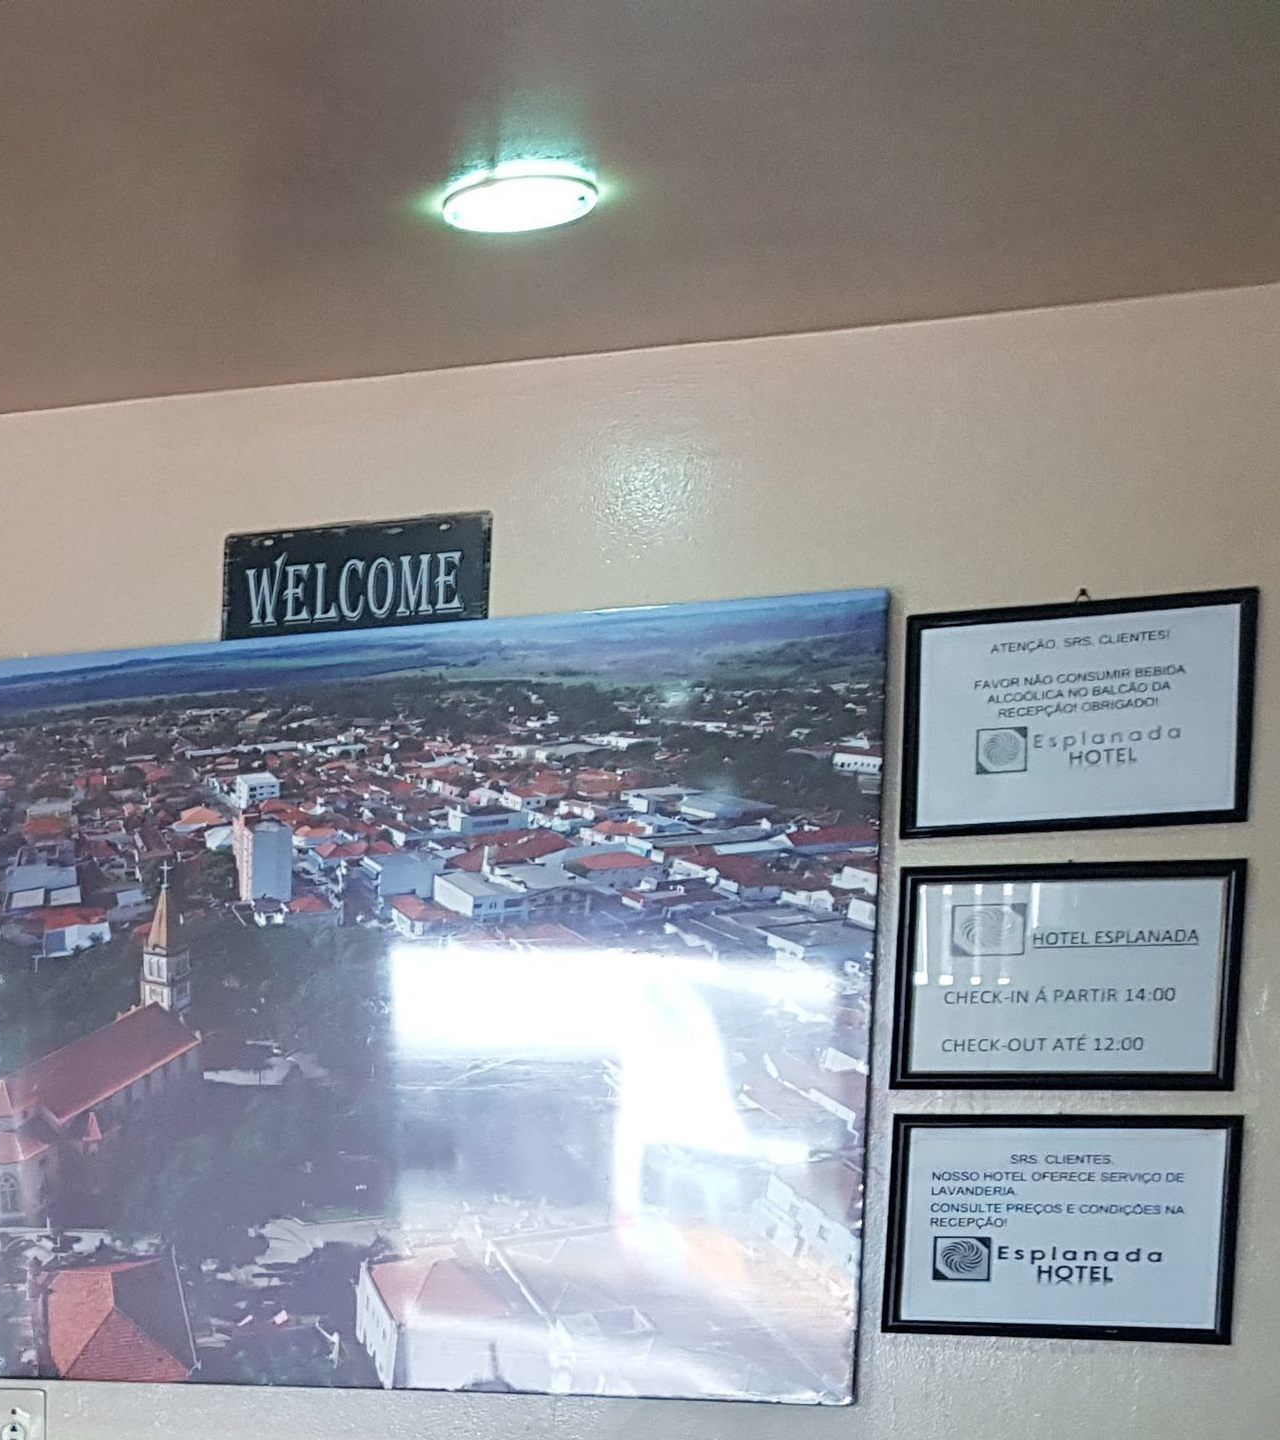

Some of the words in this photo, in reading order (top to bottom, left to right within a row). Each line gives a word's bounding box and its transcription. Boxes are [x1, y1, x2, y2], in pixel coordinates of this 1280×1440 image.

[245, 551, 464, 626] WELCOME
[974, 677, 1020, 690] FAVOR
[1023, 673, 1054, 687] NÃO
[1056, 667, 1131, 684] CONSUMIR
[1134, 664, 1186, 678] BEBIDA
[1067, 686, 1089, 699] NO
[1151, 681, 1172, 692] DA
[1081, 696, 1159, 713] OBRIGADO!
[1033, 725, 1182, 751] Esplanada
[1069, 747, 1138, 765] HOTEL
[1032, 931, 1089, 945] HOTEL
[1094, 928, 1200, 944] ESPLANADA
[943, 988, 1028, 1004] CHECK-IN
[1053, 987, 1118, 1002] PARTIR
[1125, 986, 1176, 1002] 14:00
[941, 1037, 1048, 1053] CHECK-OUT
[1052, 1033, 1088, 1052] ATÉ
[1093, 1036, 1144, 1052] 12:00
[931, 1171, 980, 1182] NOSSO
[983, 1171, 1027, 1182] HOTEL
[1031, 1171, 1096, 1182] OFERECE
[1100, 1171, 1162, 1184] SERVIÇO
[1165, 1172, 1185, 1182] DE
[930, 1202, 1003, 1213] CONSULTE
[1006, 1203, 1062, 1215] PREÇOS
[1066, 1203, 1075, 1213] E
[1078, 1202, 1161, 1216] CONDIÇÕES
[1165, 1204, 1185, 1215] NA
[997, 1246, 1163, 1265] Esplanada
[1037, 1265, 1114, 1283] HOTEL
